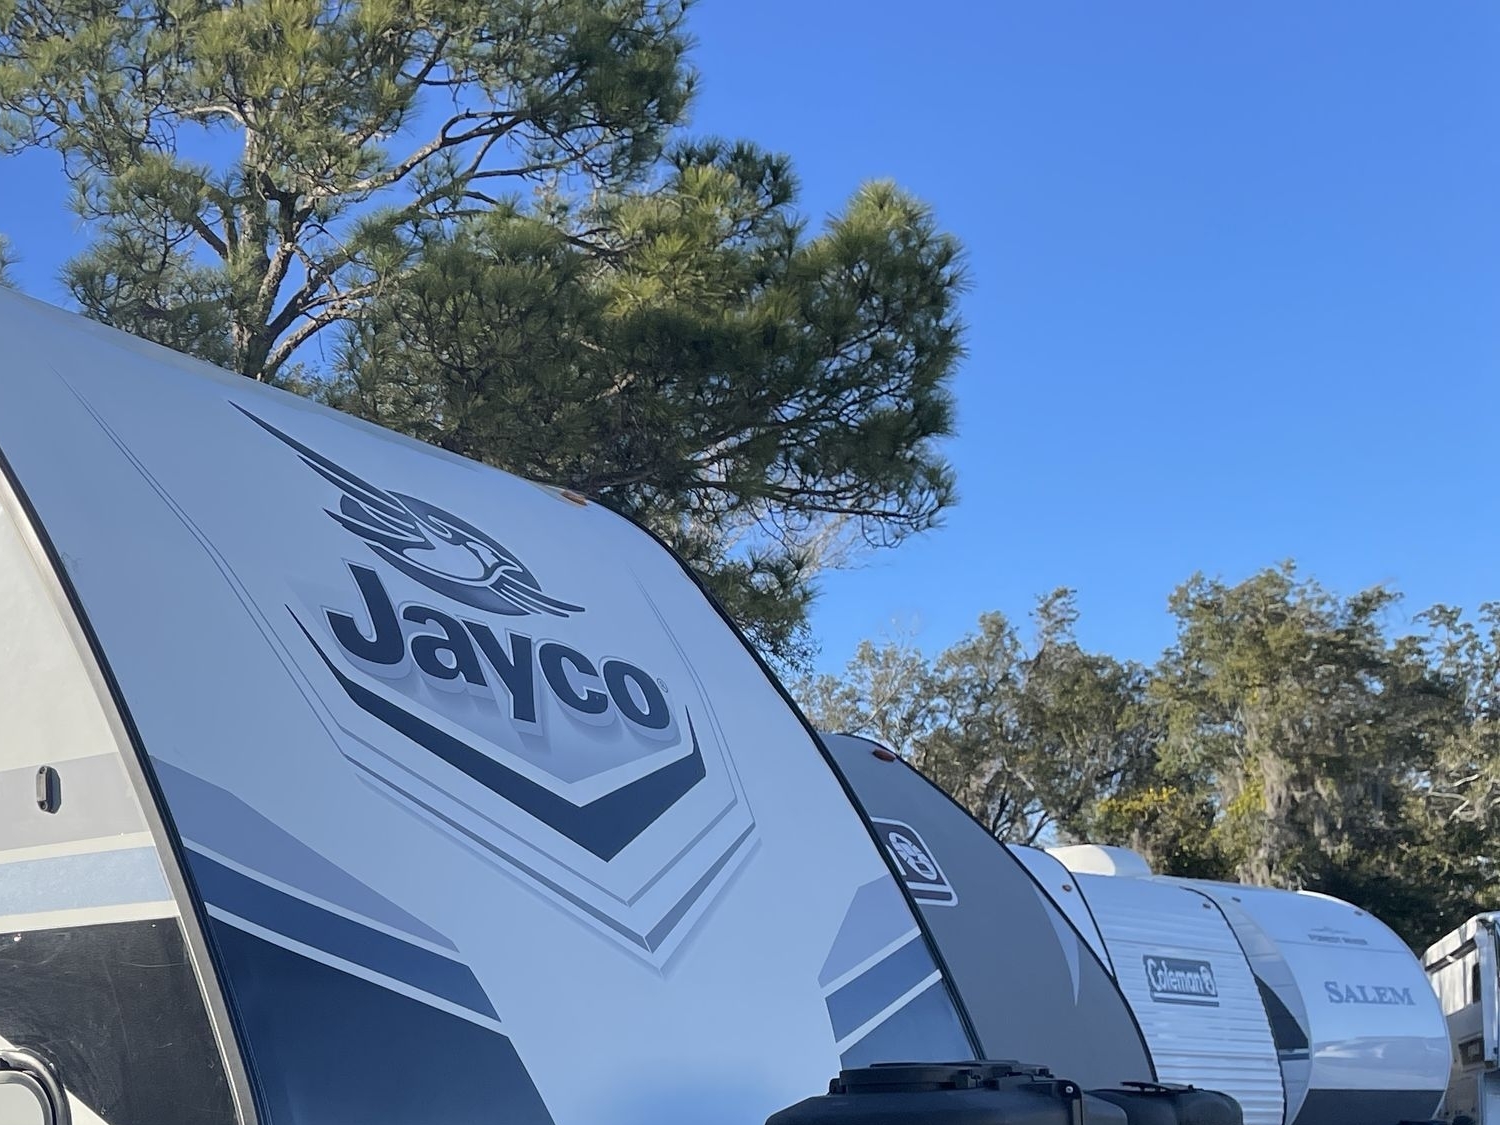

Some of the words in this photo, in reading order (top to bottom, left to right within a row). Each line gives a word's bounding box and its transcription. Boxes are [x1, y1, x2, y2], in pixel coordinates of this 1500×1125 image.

[325, 562, 671, 730] Jayco
[1146, 958, 1206, 994] Coleman
[1324, 981, 1416, 1006] SALEM
